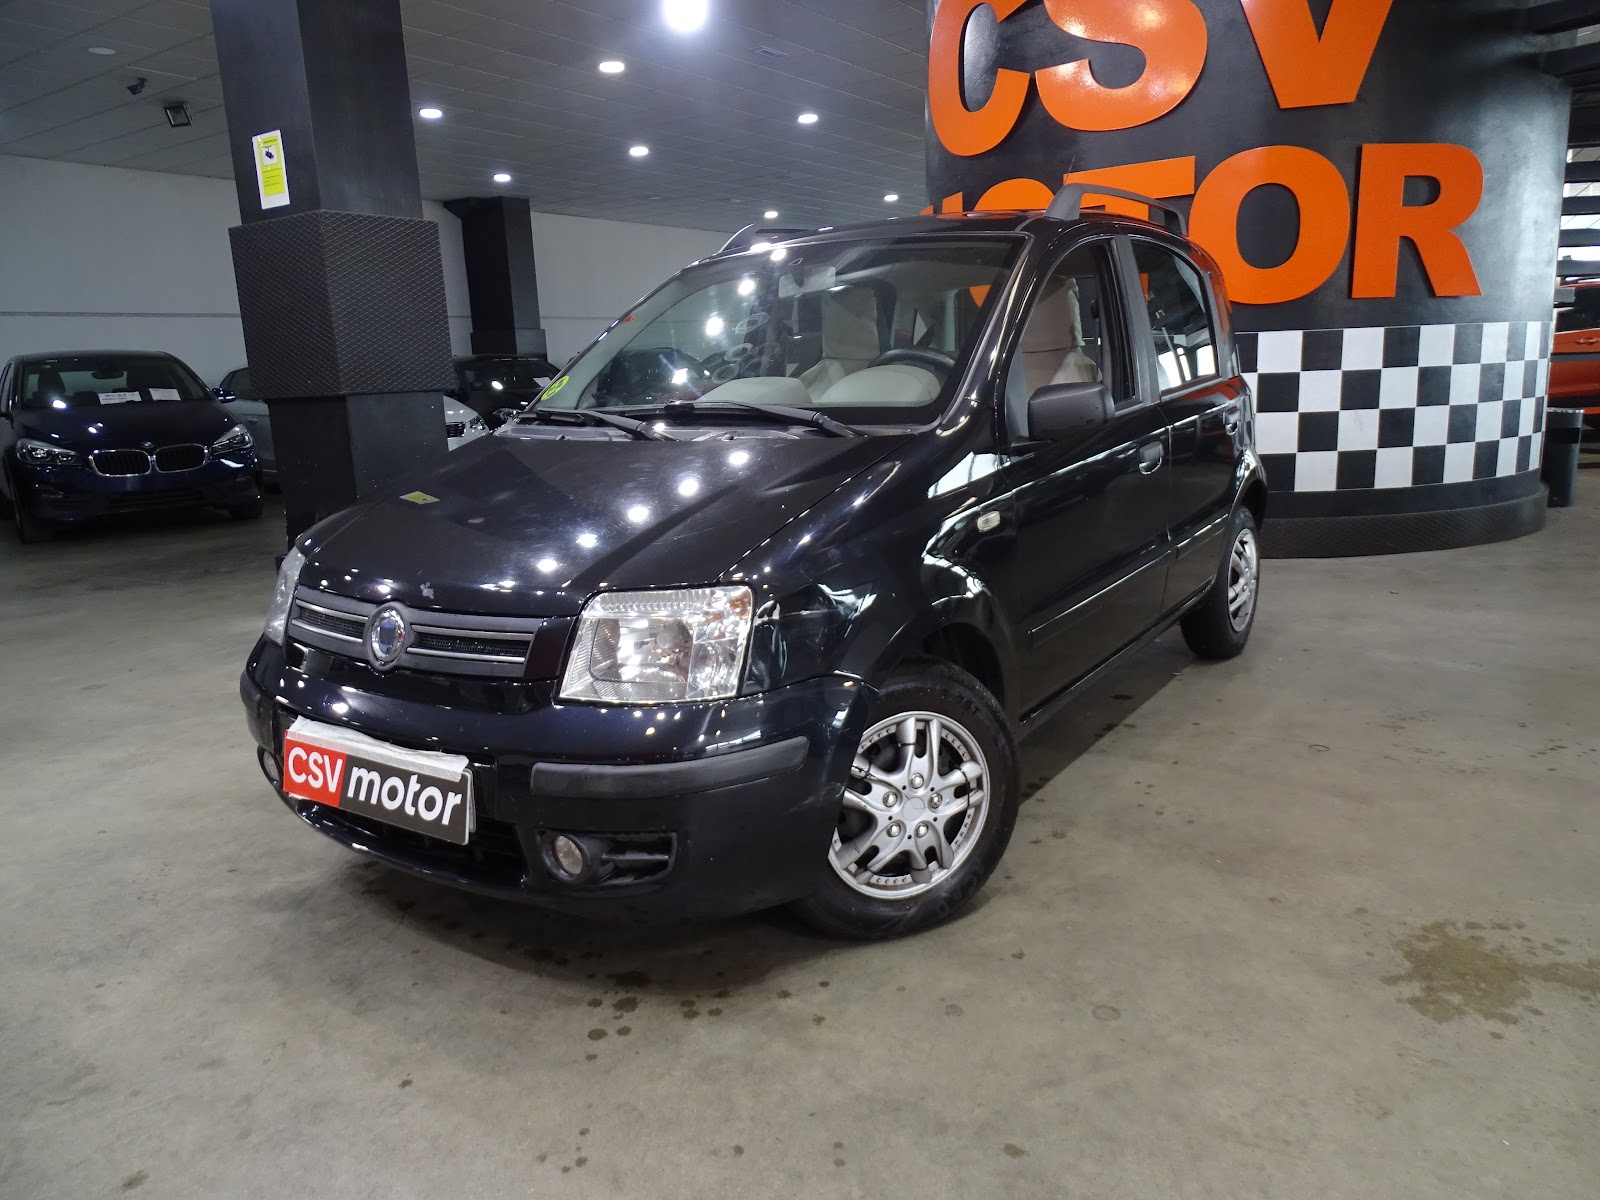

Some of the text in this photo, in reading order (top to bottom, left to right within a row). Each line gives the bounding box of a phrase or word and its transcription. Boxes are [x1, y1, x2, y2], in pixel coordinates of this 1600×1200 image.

[928, 0, 1393, 157] CSV
[920, 143, 1484, 305] TOR
[287, 746, 463, 826] CSV motor
